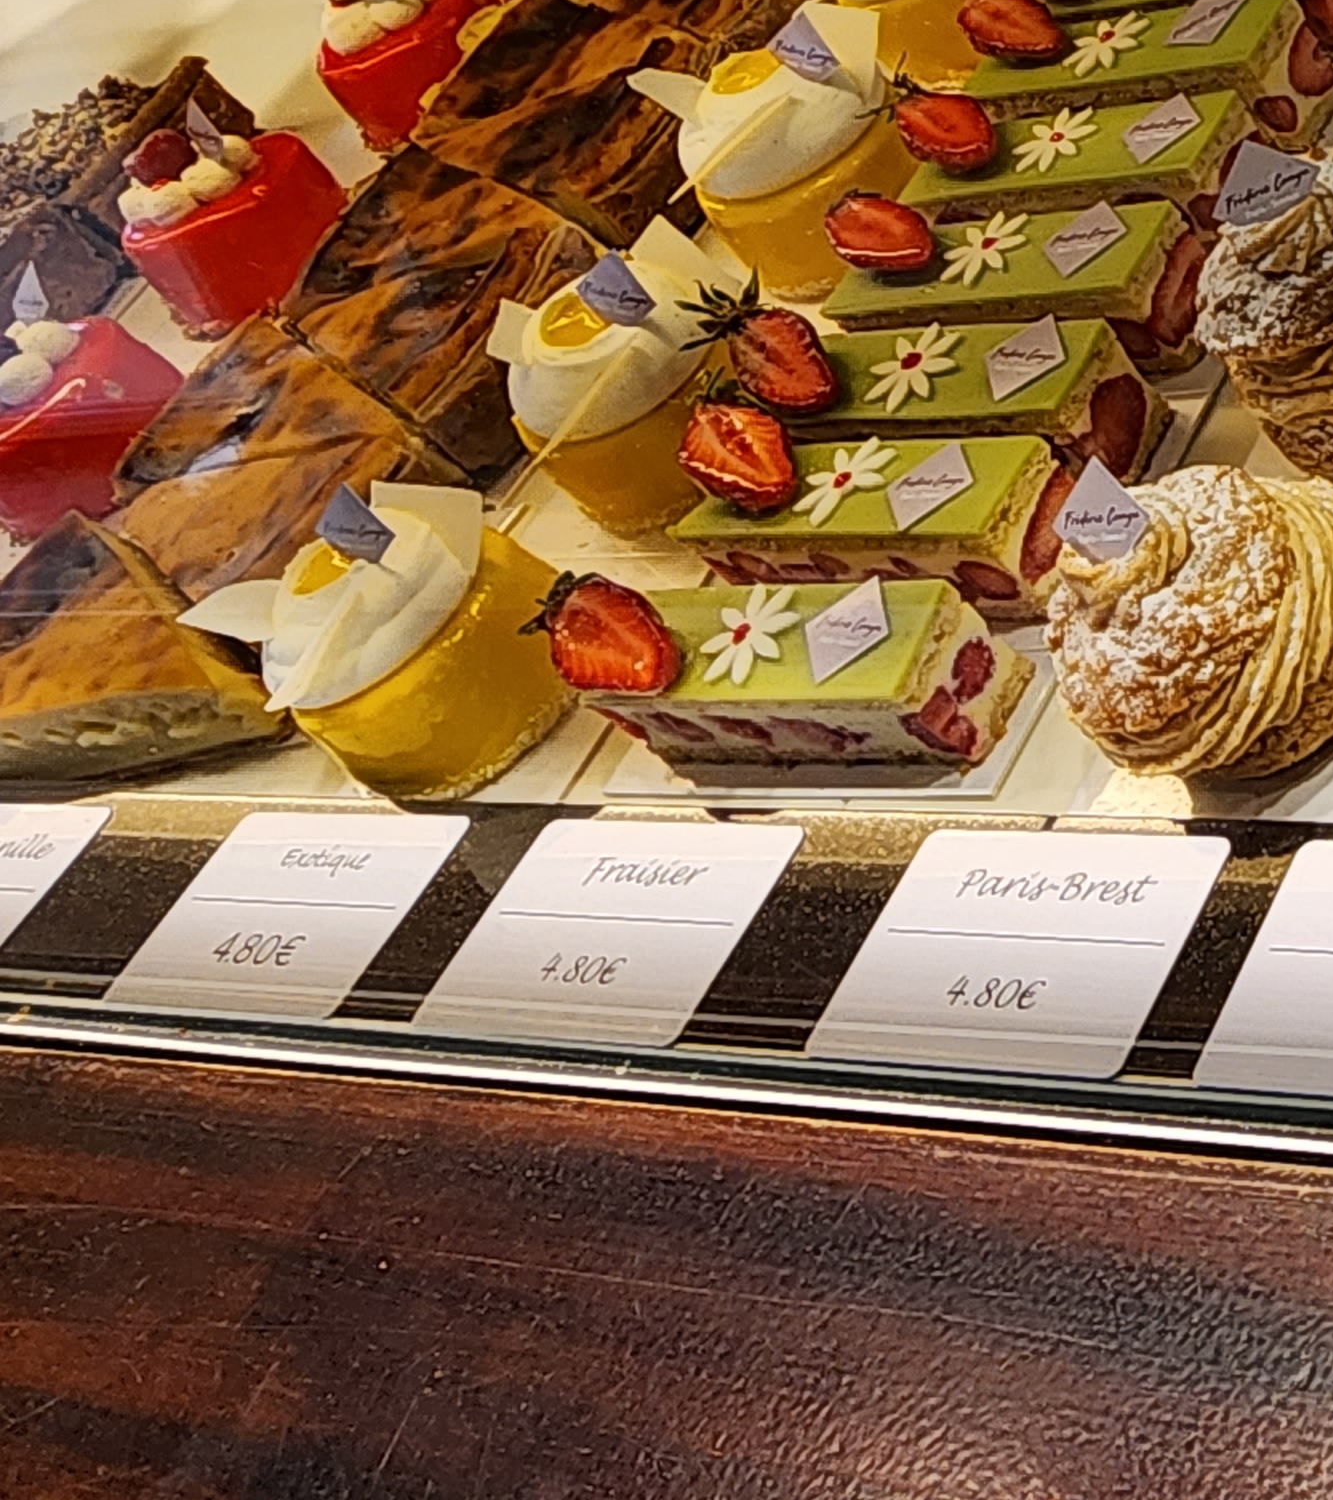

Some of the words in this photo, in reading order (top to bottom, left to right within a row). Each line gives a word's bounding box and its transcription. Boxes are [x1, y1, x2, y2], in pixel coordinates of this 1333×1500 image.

[280, 844, 372, 878] Exotique
[581, 856, 710, 888] Fraisier
[955, 868, 1159, 906] Paris-Brest
[211, 931, 307, 967] 4.80€
[540, 952, 628, 985] 4.80€
[946, 974, 1048, 1010] 4.80€
